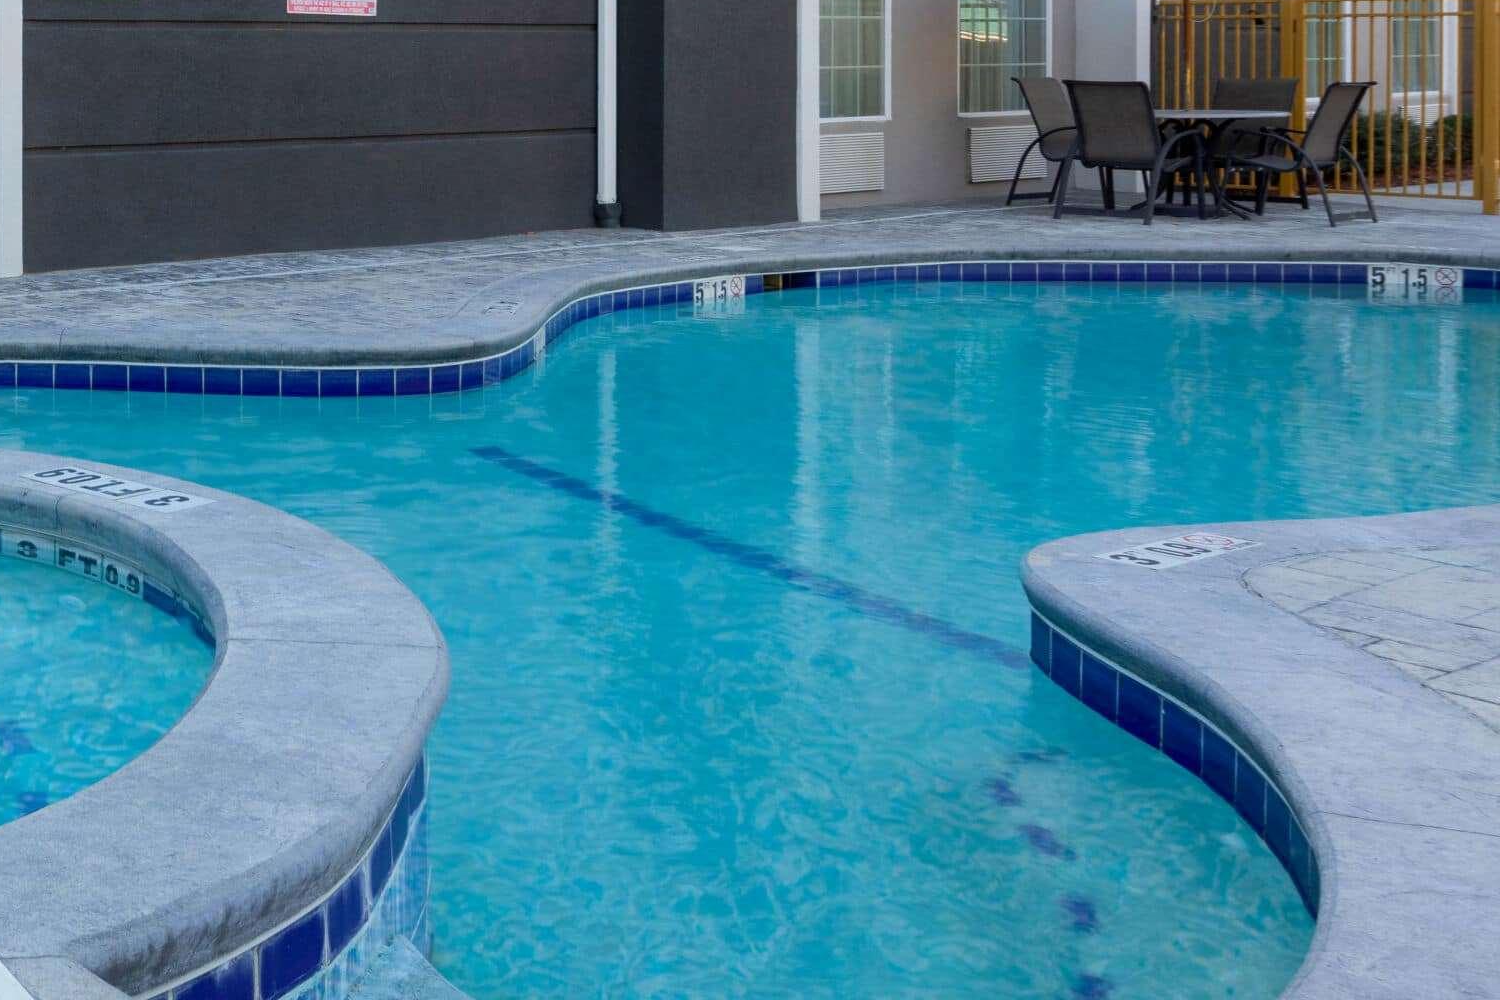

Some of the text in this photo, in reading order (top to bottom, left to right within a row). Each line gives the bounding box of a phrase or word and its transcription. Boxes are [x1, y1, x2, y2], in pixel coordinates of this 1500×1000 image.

[1371, 266, 1386, 287] 5
[695, 282, 705, 303] 5
[145, 494, 191, 507] 3
[16, 540, 38, 559] 3
[1109, 553, 1161, 566] 3
